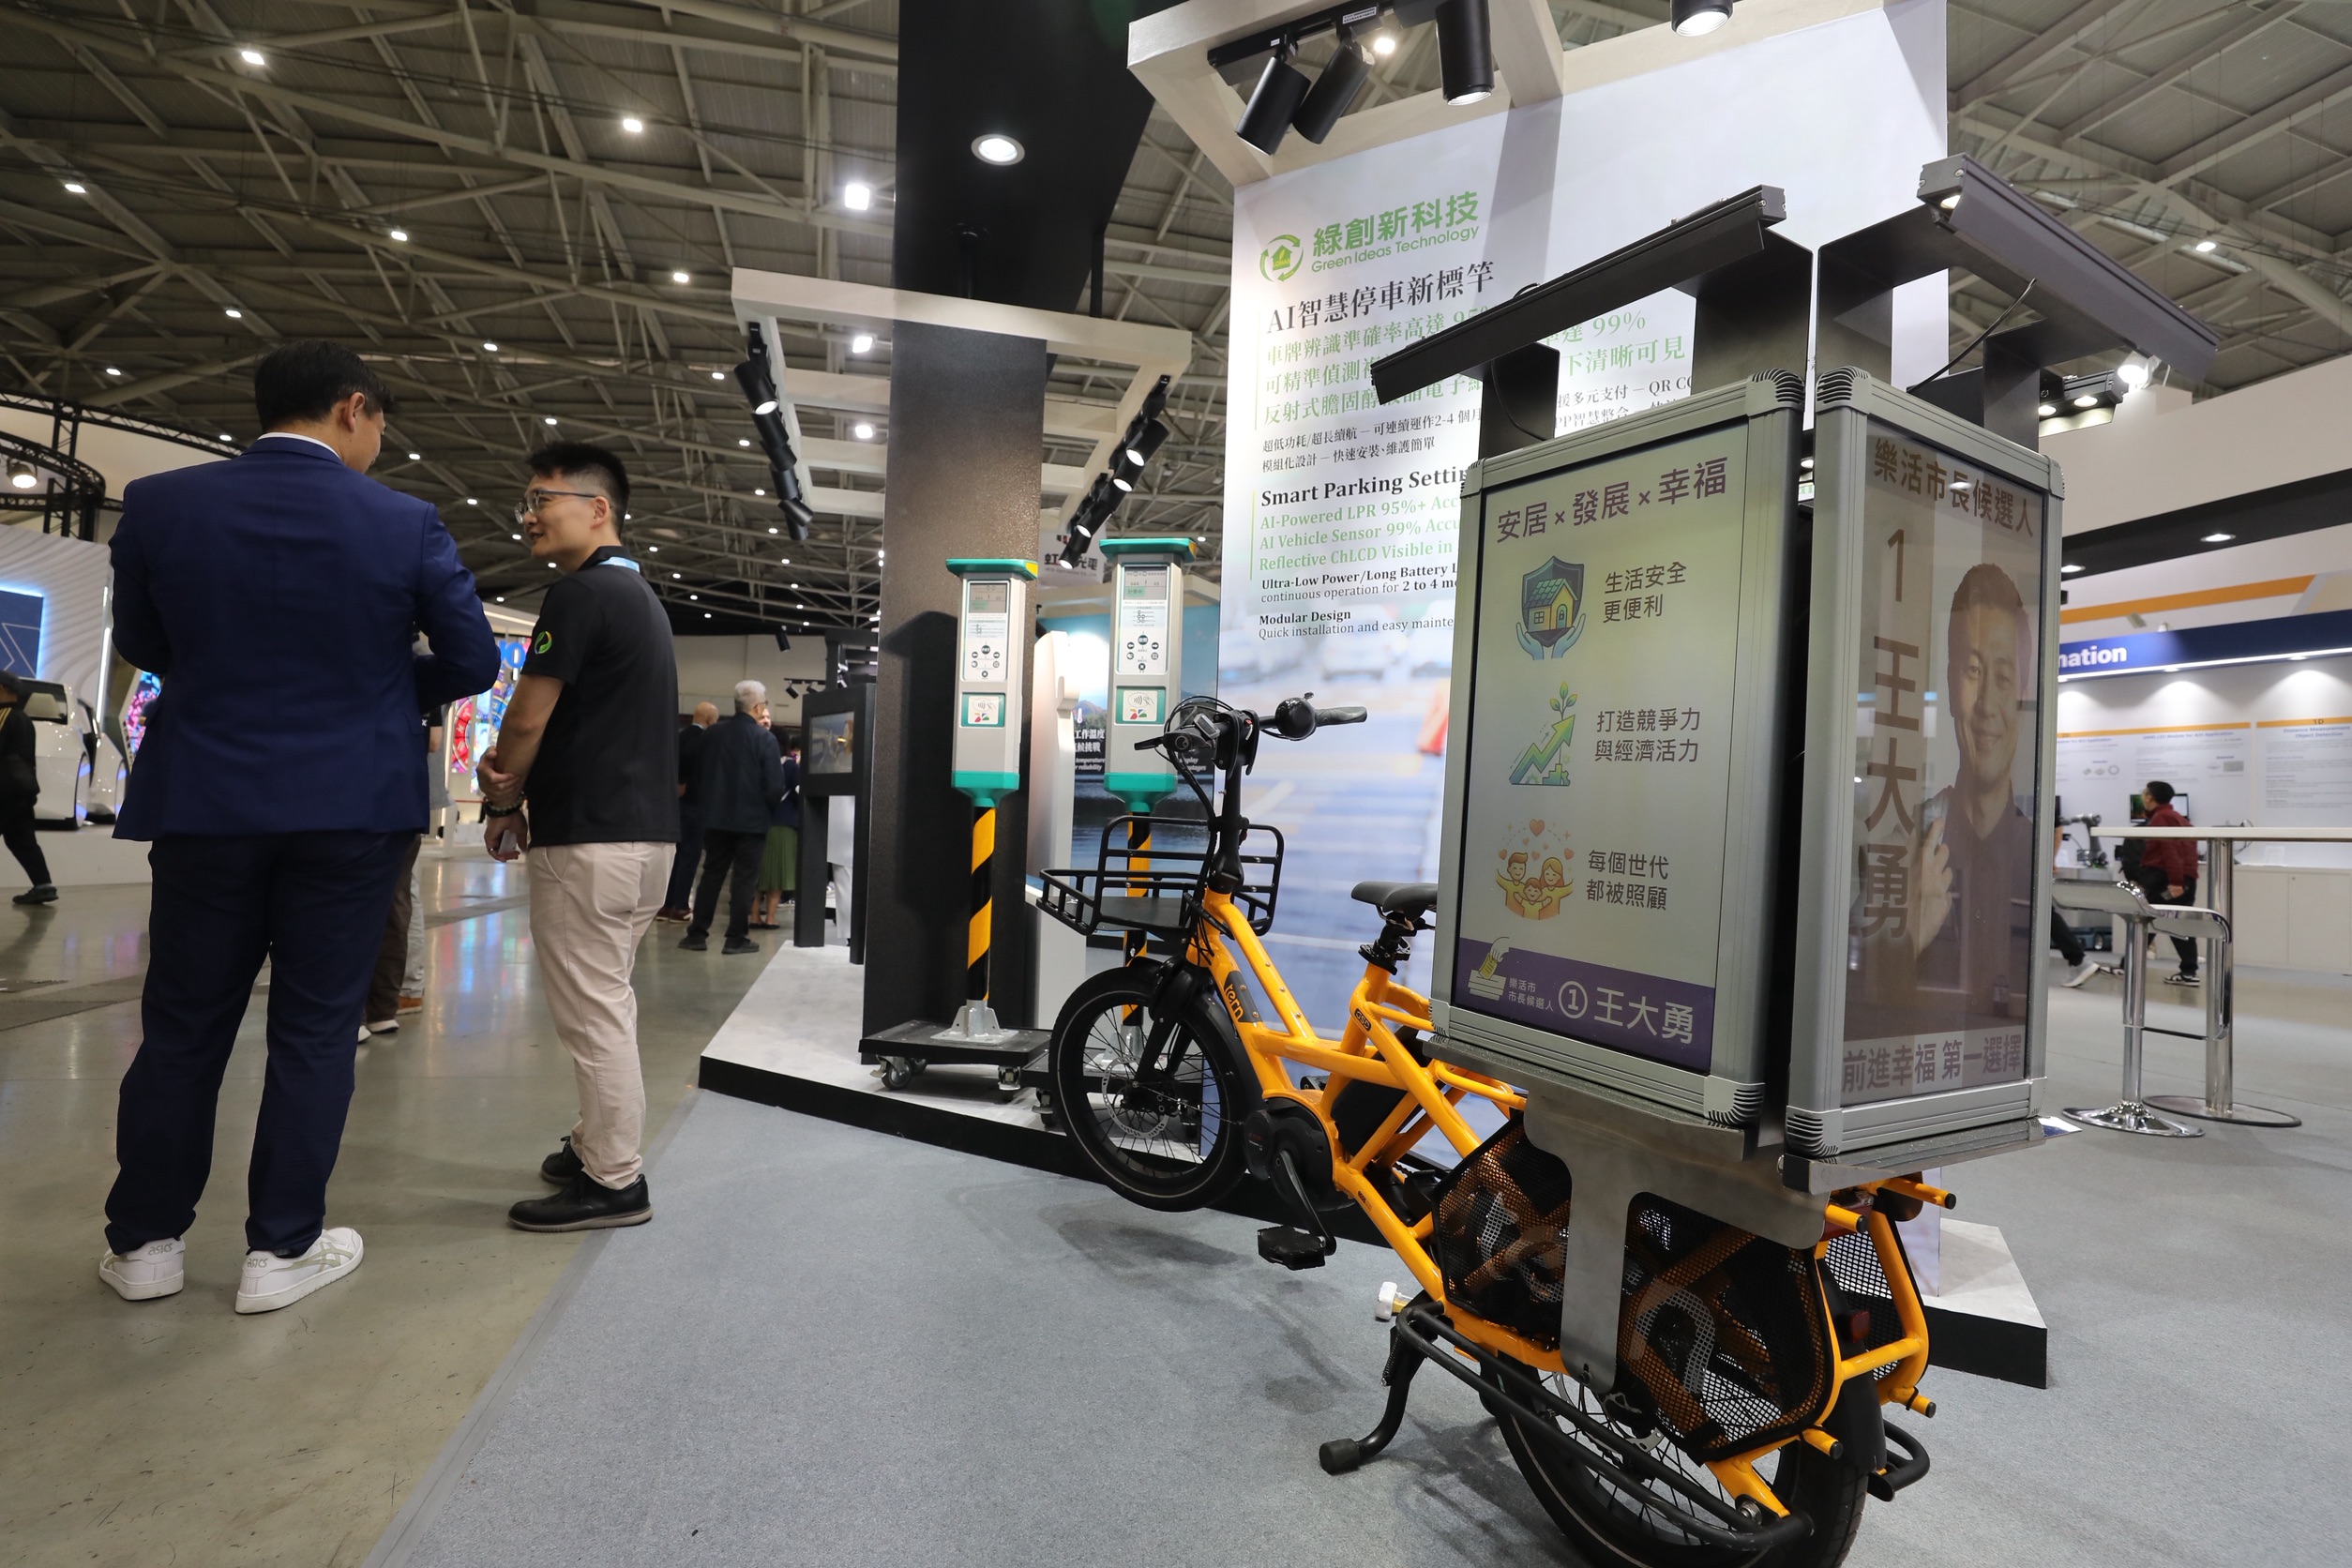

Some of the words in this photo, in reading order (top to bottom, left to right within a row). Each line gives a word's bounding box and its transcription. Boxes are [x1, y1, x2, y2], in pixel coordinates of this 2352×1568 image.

[1312, 191, 1479, 258] 綠創新科技
[1312, 255, 1352, 273] Green
[1355, 246, 1392, 264] Ideas
[1395, 225, 1479, 252] Technology
[1267, 261, 1494, 335] AI智慧停車新標竿
[1592, 310, 1646, 338] 99%
[1267, 312, 1445, 367] 車牌辨識準確率高達
[1560, 335, 1686, 377] 下清晰可見
[1649, 379, 1671, 397] QR
[1262, 427, 1358, 454] 超低功耗/超長續航
[1262, 453, 1318, 474] 模組化設計
[1261, 485, 1319, 507] Smart
[1323, 476, 1404, 499] Parking
[1874, 437, 2034, 538] 樂活市長候選人
[1260, 507, 1343, 530] AI-Powered
[1348, 504, 1377, 520] LPR
[1380, 499, 1426, 516] 95%+
[1259, 536, 1274, 550] AI
[1278, 530, 1328, 549] Vehicle
[1332, 526, 1381, 543] Sensor
[1386, 520, 1422, 536] 99%
[1044, 552, 1098, 570] 虹光電
[1259, 551, 1326, 571] Reflective
[1331, 547, 1378, 565] ChLCD
[1381, 541, 1434, 560] Visible
[1438, 539, 1453, 554] in
[1887, 528, 1905, 603] 1
[1260, 586, 1321, 603] continuous
[1324, 583, 1380, 600] operation
[1382, 581, 1399, 594] for
[1402, 580, 1410, 592] 2
[1413, 580, 1426, 591] to
[1429, 579, 1439, 589] 4
[1261, 576, 1319, 590] Ultra-Low
[1321, 568, 1396, 585] Power/Long
[1400, 564, 1448, 579] Battery
[1605, 560, 1687, 595] 生活安全
[1259, 611, 1308, 626] Modular
[1310, 610, 1351, 624] Design
[1603, 594, 1664, 624] 更便利
[1259, 626, 1289, 641] Quick
[1291, 622, 1355, 637] installation
[1357, 620, 1380, 632] and
[1381, 620, 1409, 632] easy
[1596, 707, 1701, 733] 打造競爭力
[1594, 738, 1699, 762] 與經濟活力
[1861, 635, 1920, 939] 王大勇
[1588, 850, 1669, 881] 每個世代
[1586, 879, 1668, 911] 都被照顧
[1508, 976, 1537, 993] 樂活市
[1225, 983, 1245, 1020] tern
[1508, 990, 1554, 1013] 市長候選人
[1593, 986, 1694, 1045] 王大勇
[1356, 1011, 1370, 1029] GSD
[1842, 1043, 1937, 1093] 前進幸福
[1941, 1033, 2022, 1080] 第一選擇
[148, 1243, 173, 1256] asics
[247, 1258, 269, 1269] asics
